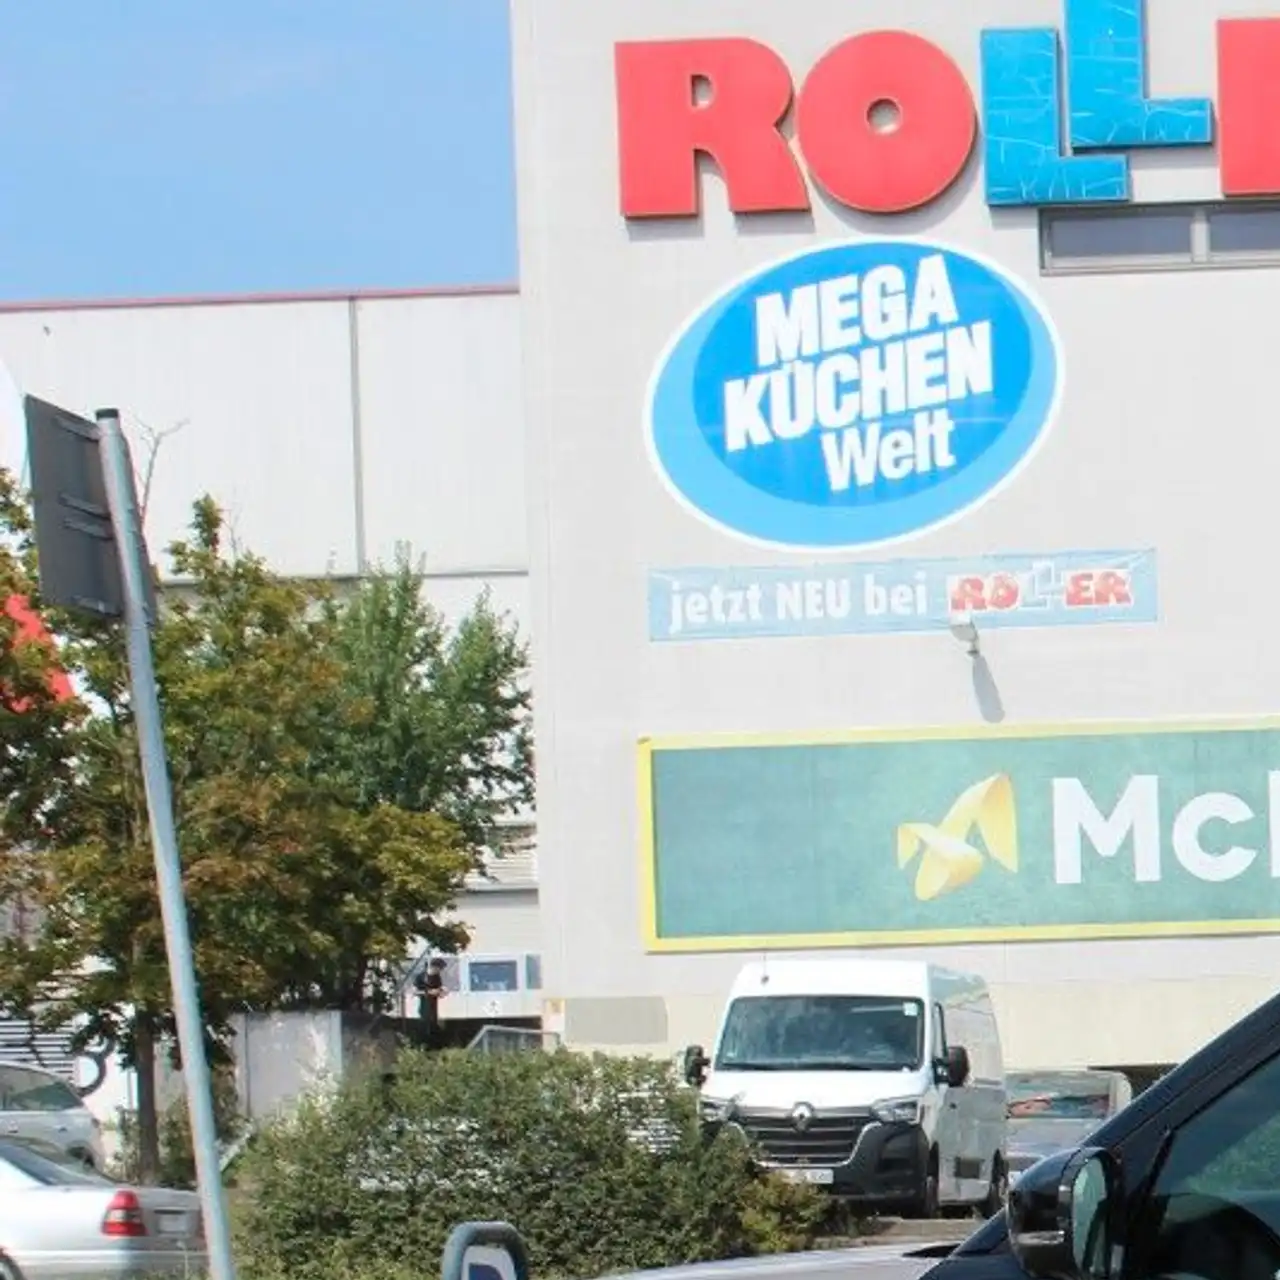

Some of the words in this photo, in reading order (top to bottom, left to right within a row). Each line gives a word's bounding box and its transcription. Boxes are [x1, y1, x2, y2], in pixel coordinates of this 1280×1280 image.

[755, 253, 959, 367] MEGA
[820, 407, 956, 492] Welt
[669, 583, 762, 634] jetzt
[776, 578, 851, 620] NEU
[864, 571, 927, 617] bei
